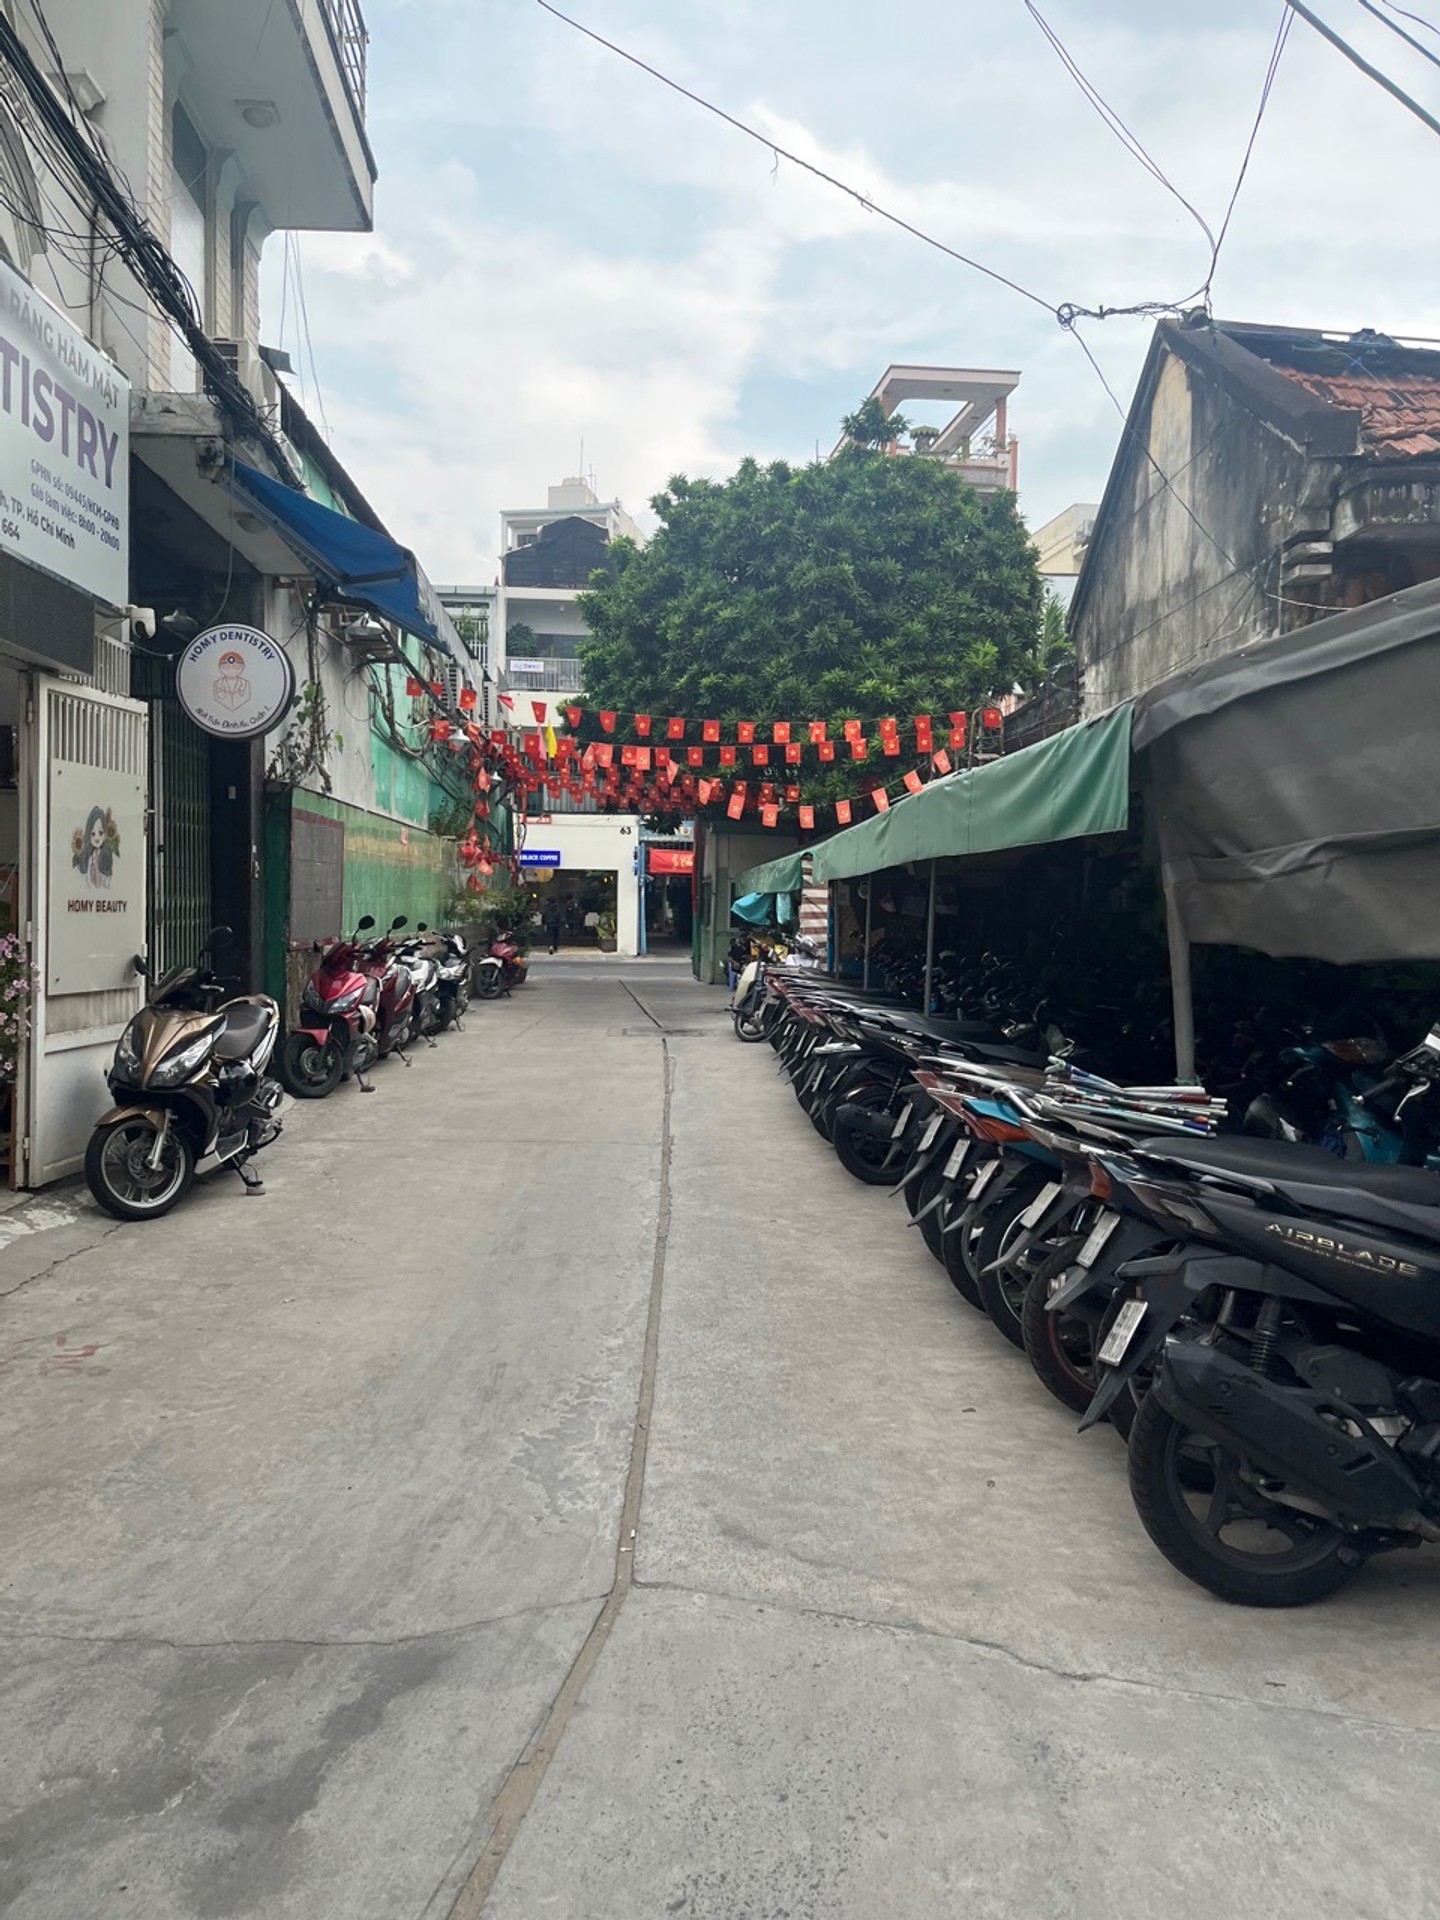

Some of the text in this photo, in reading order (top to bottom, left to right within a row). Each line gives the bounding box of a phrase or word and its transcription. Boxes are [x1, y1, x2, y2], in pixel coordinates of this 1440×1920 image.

[10, 287, 119, 410] RĂNG HÀM MẶT
[55, 524, 76, 550] Minh
[188, 631, 276, 663] HOMY DENTISTRY
[619, 826, 632, 836] 63
[67, 899, 128, 914] HOMY BEAUTY
